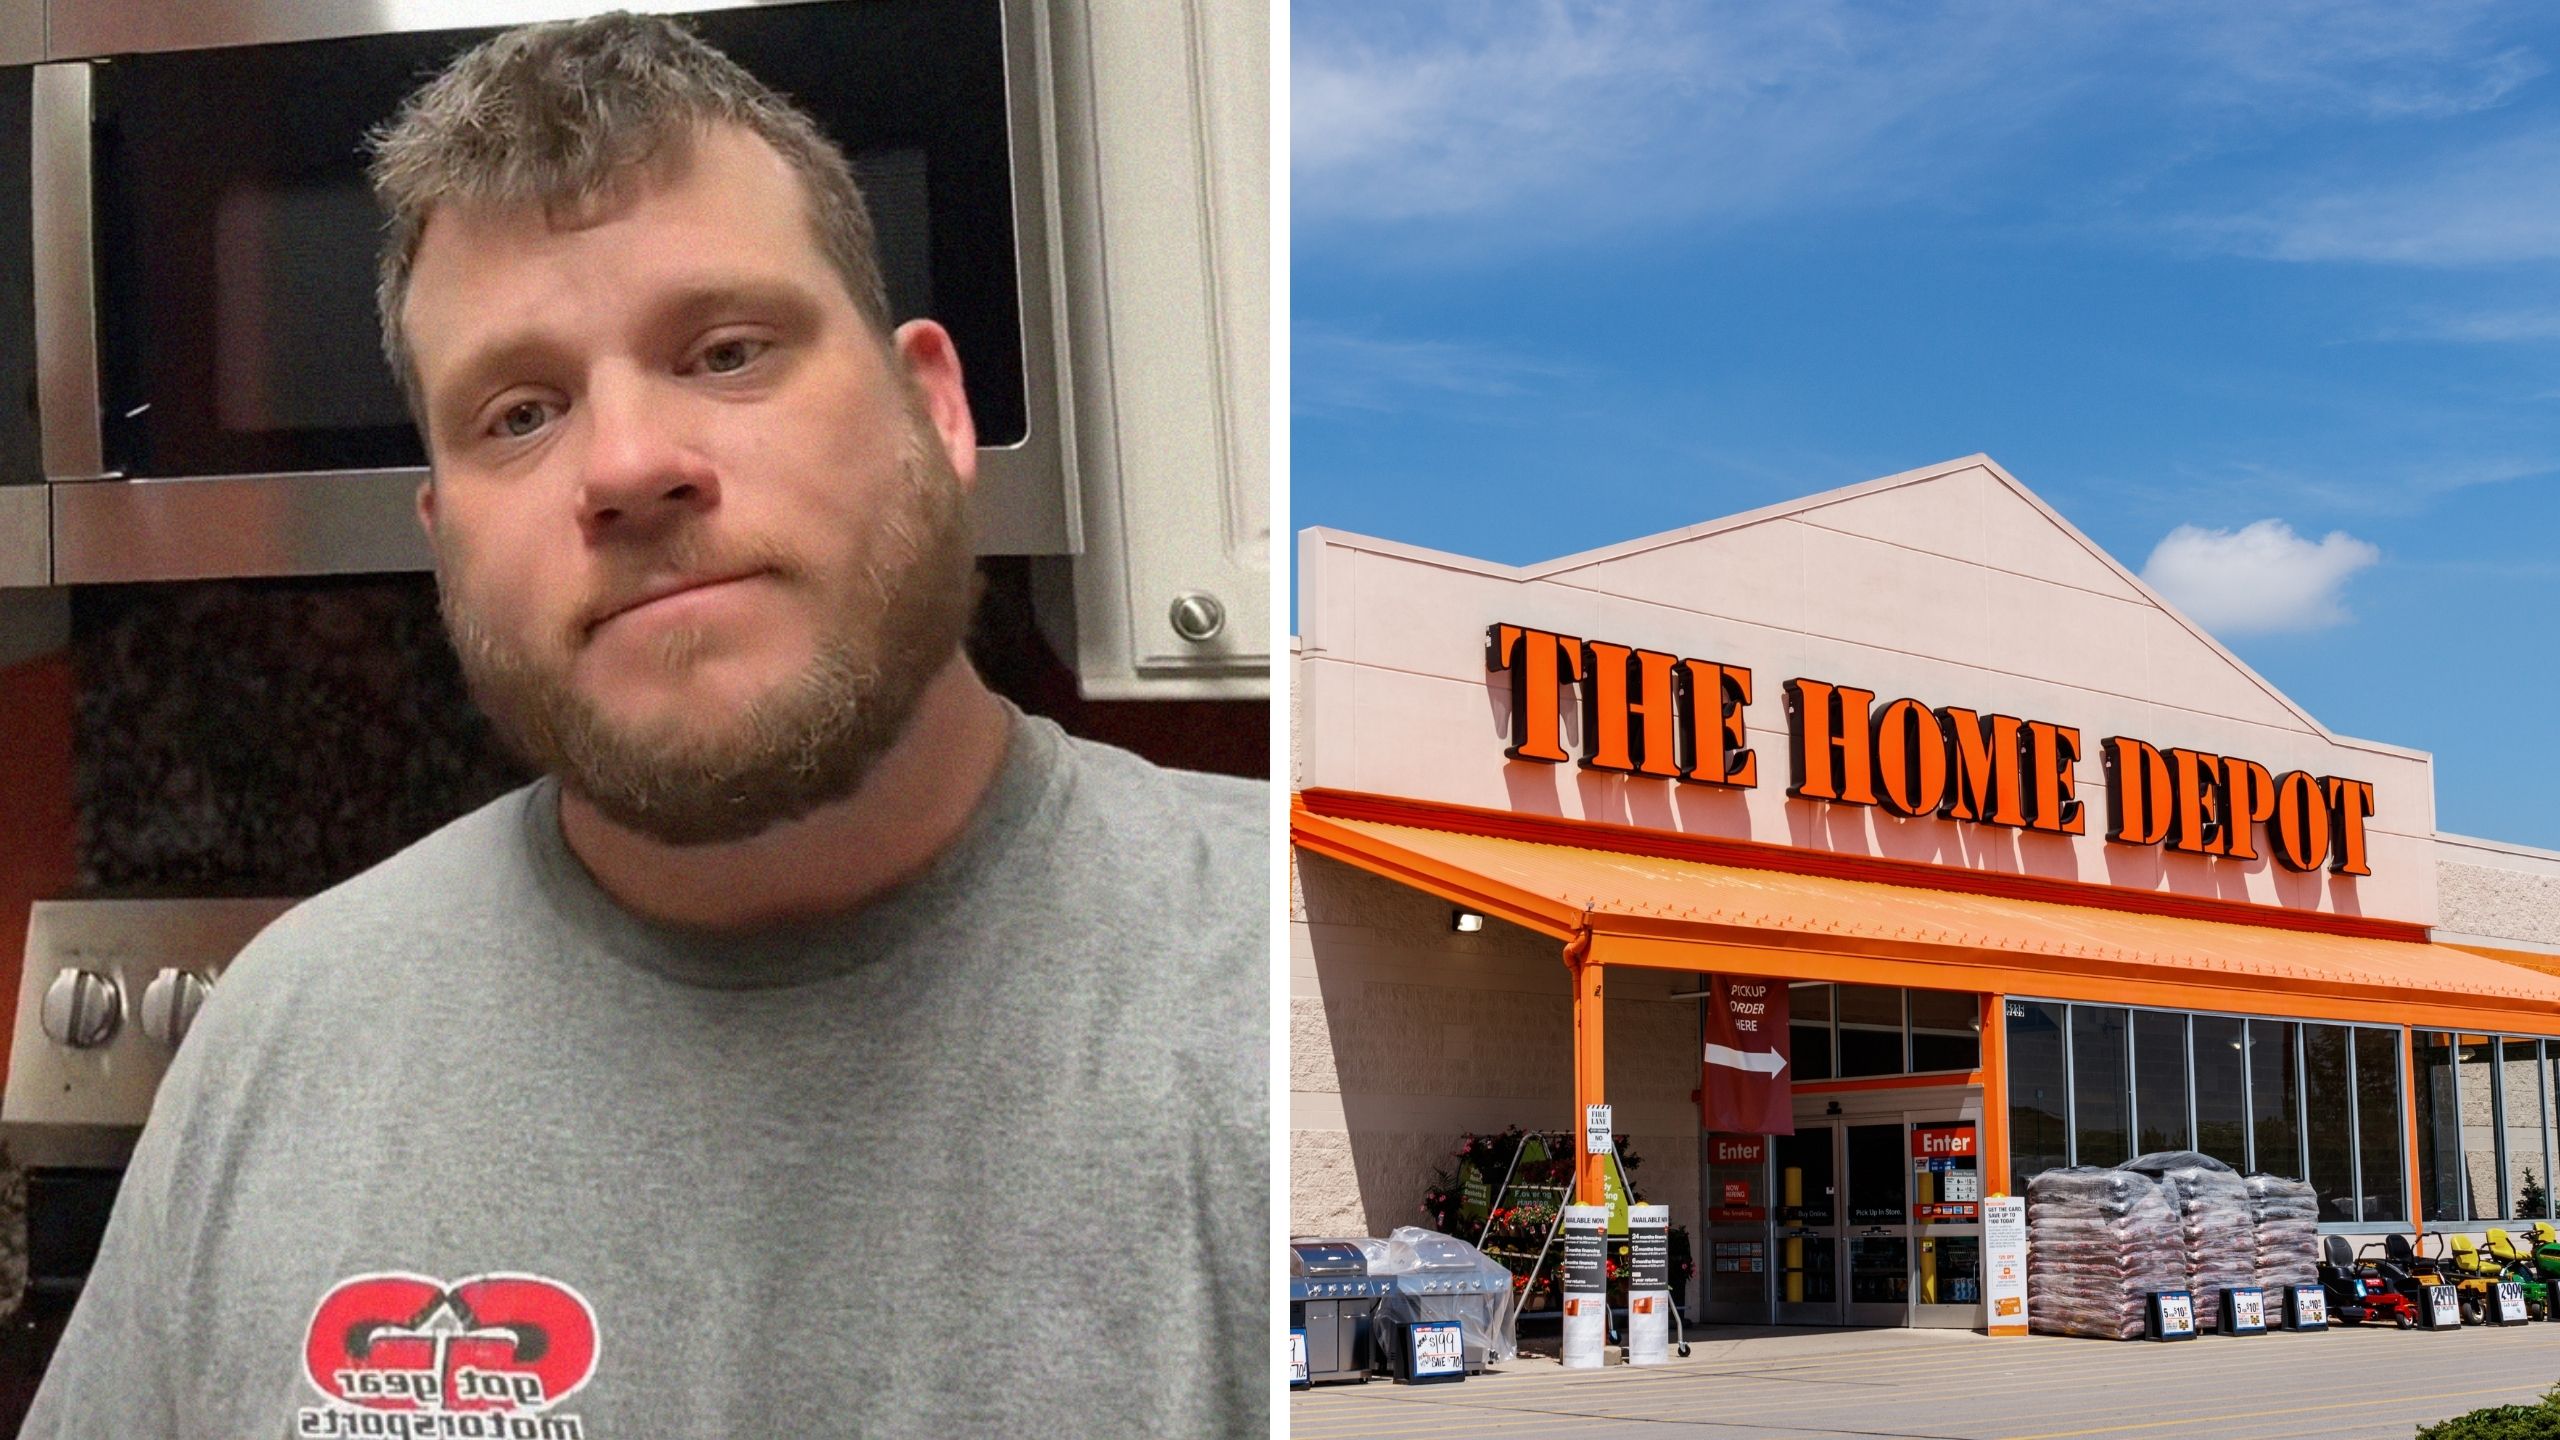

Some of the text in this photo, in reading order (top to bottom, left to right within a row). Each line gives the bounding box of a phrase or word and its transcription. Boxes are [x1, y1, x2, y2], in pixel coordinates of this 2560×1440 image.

[1486, 621, 2376, 876] THE HOME DEPOT
[1731, 984, 1767, 998] PICKUP
[1729, 1000, 1765, 1015] ORDER
[1735, 1019, 1758, 1032] HERE
[1923, 1133, 1971, 1153] Enter
[1719, 1142, 1760, 1160] Enter
[1869, 1209, 1878, 1217] Up
[2236, 1303, 2242, 1314] 5
[2300, 1300, 2305, 1311] 5
[2163, 1307, 2169, 1319] 5
[1429, 1332, 1454, 1354] $199
[1431, 1356, 1446, 1368] SAVE
